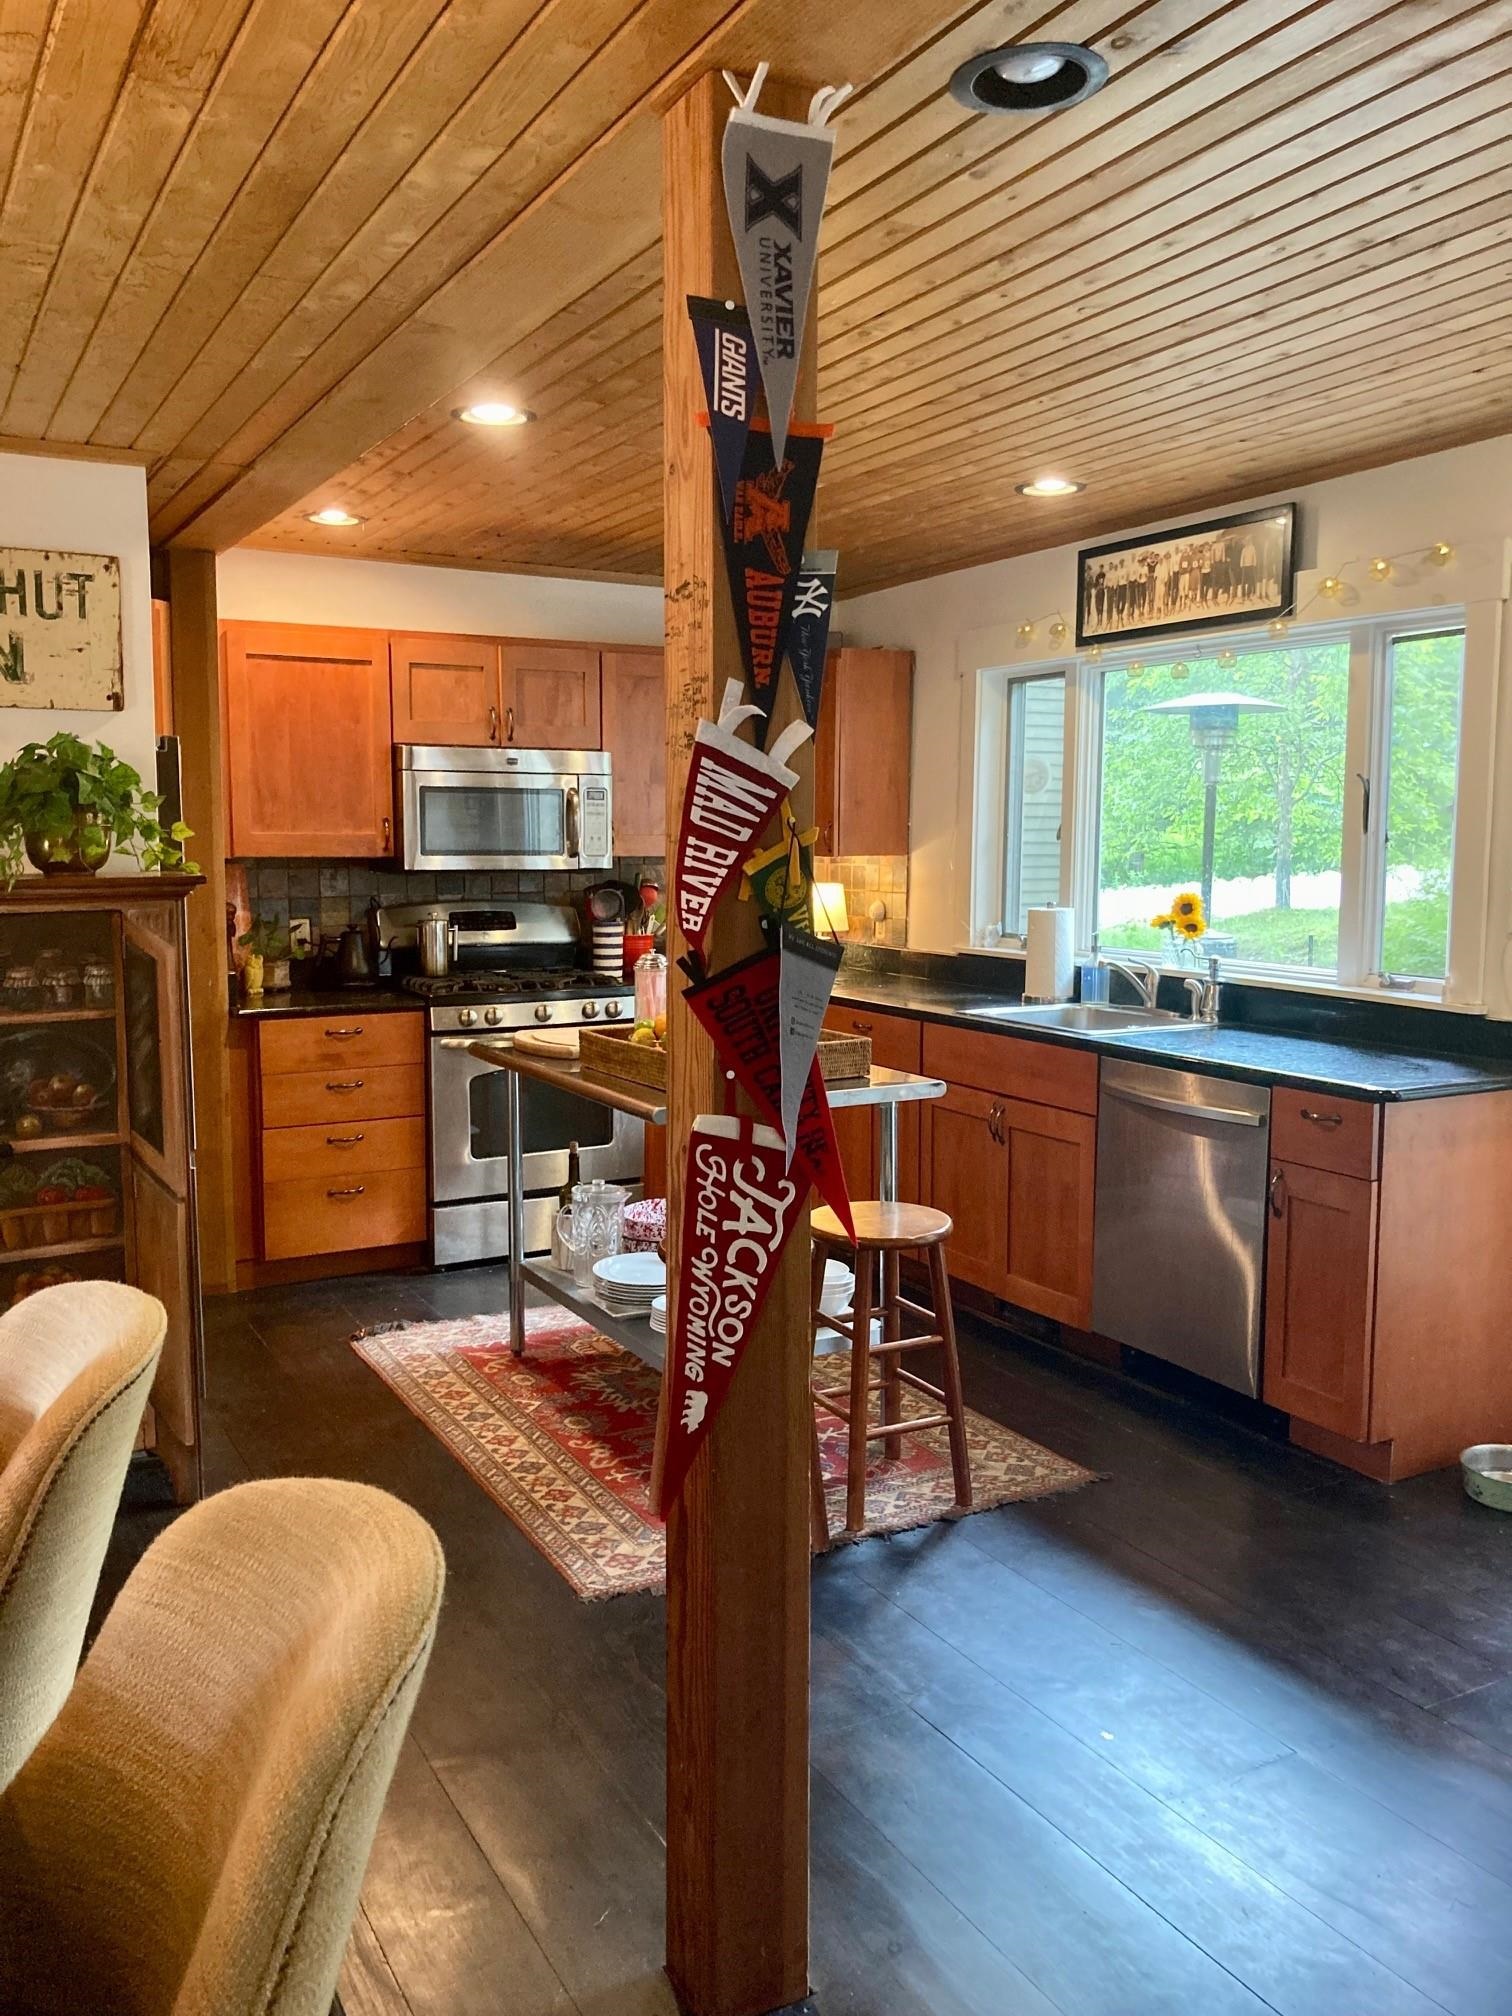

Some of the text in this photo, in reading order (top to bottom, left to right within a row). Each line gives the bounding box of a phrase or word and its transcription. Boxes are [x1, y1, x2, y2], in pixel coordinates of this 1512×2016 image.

[759, 237, 776, 362] UNIVERSITY
[773, 239, 796, 360] XAVIER
[721, 330, 747, 422] GIANTS
[0, 568, 95, 621] HUT
[744, 567, 785, 690] AUBURN
[689, 755, 778, 843] MAD
[680, 836, 739, 933] RIVER
[707, 983, 770, 1066] SOUTH
[685, 1143, 726, 1383] HOLE WYOMING
[710, 1154, 796, 1369] JACKSON
